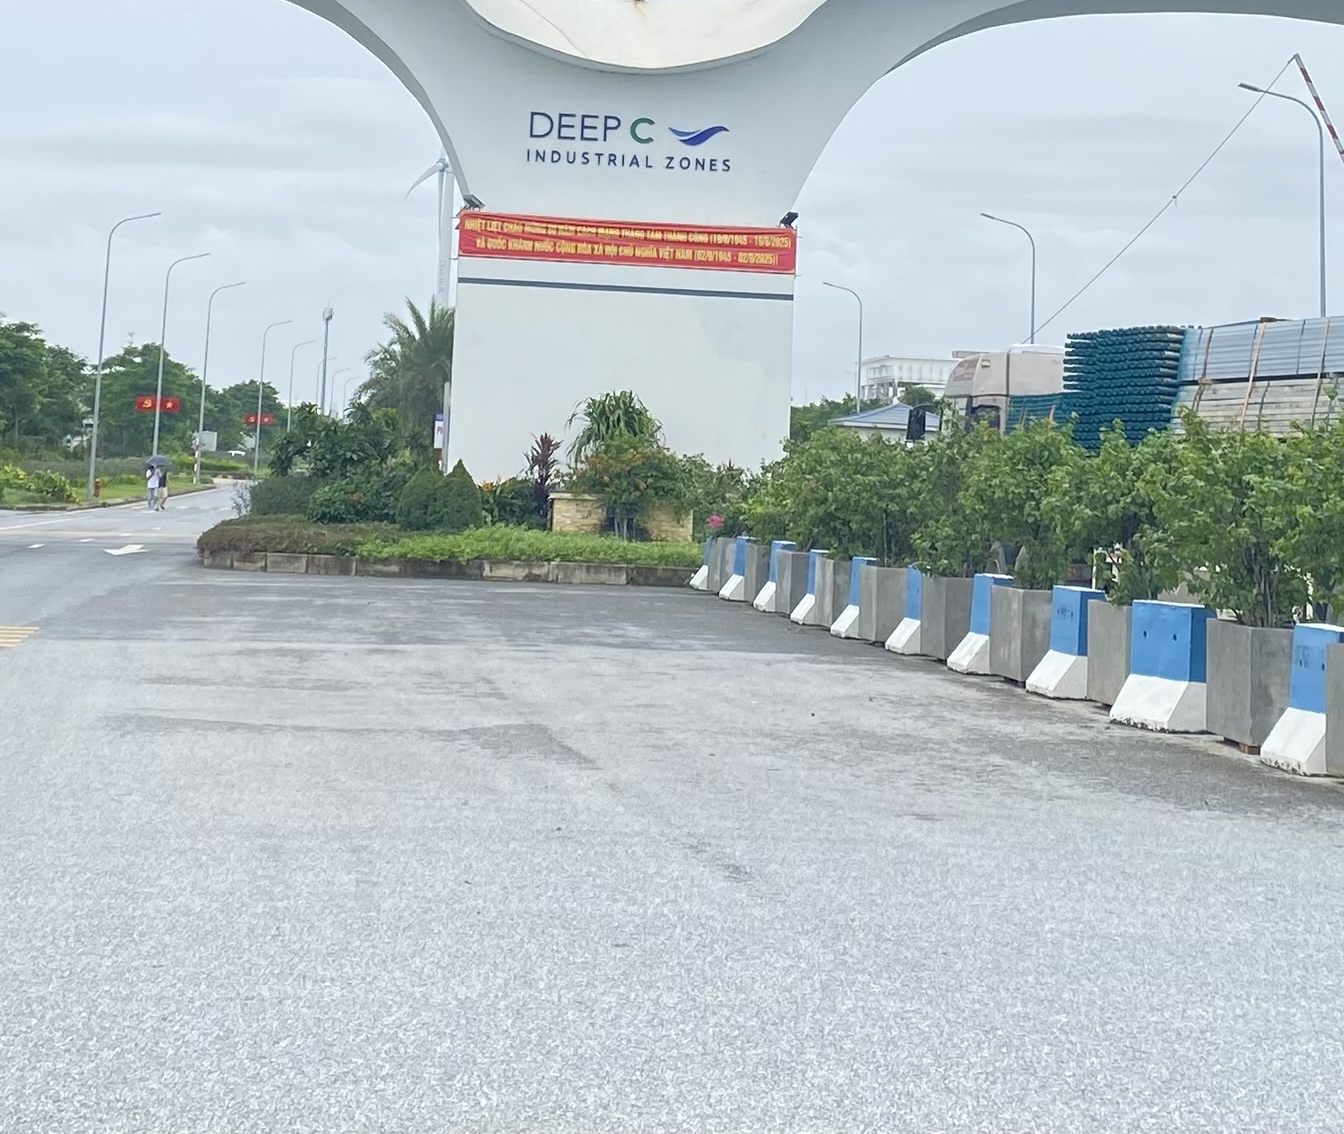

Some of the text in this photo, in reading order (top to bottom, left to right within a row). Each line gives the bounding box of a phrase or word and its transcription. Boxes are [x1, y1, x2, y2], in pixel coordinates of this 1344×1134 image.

[529, 111, 655, 144] DEEP C
[526, 149, 731, 172] INDUSTRIAL ZONES
